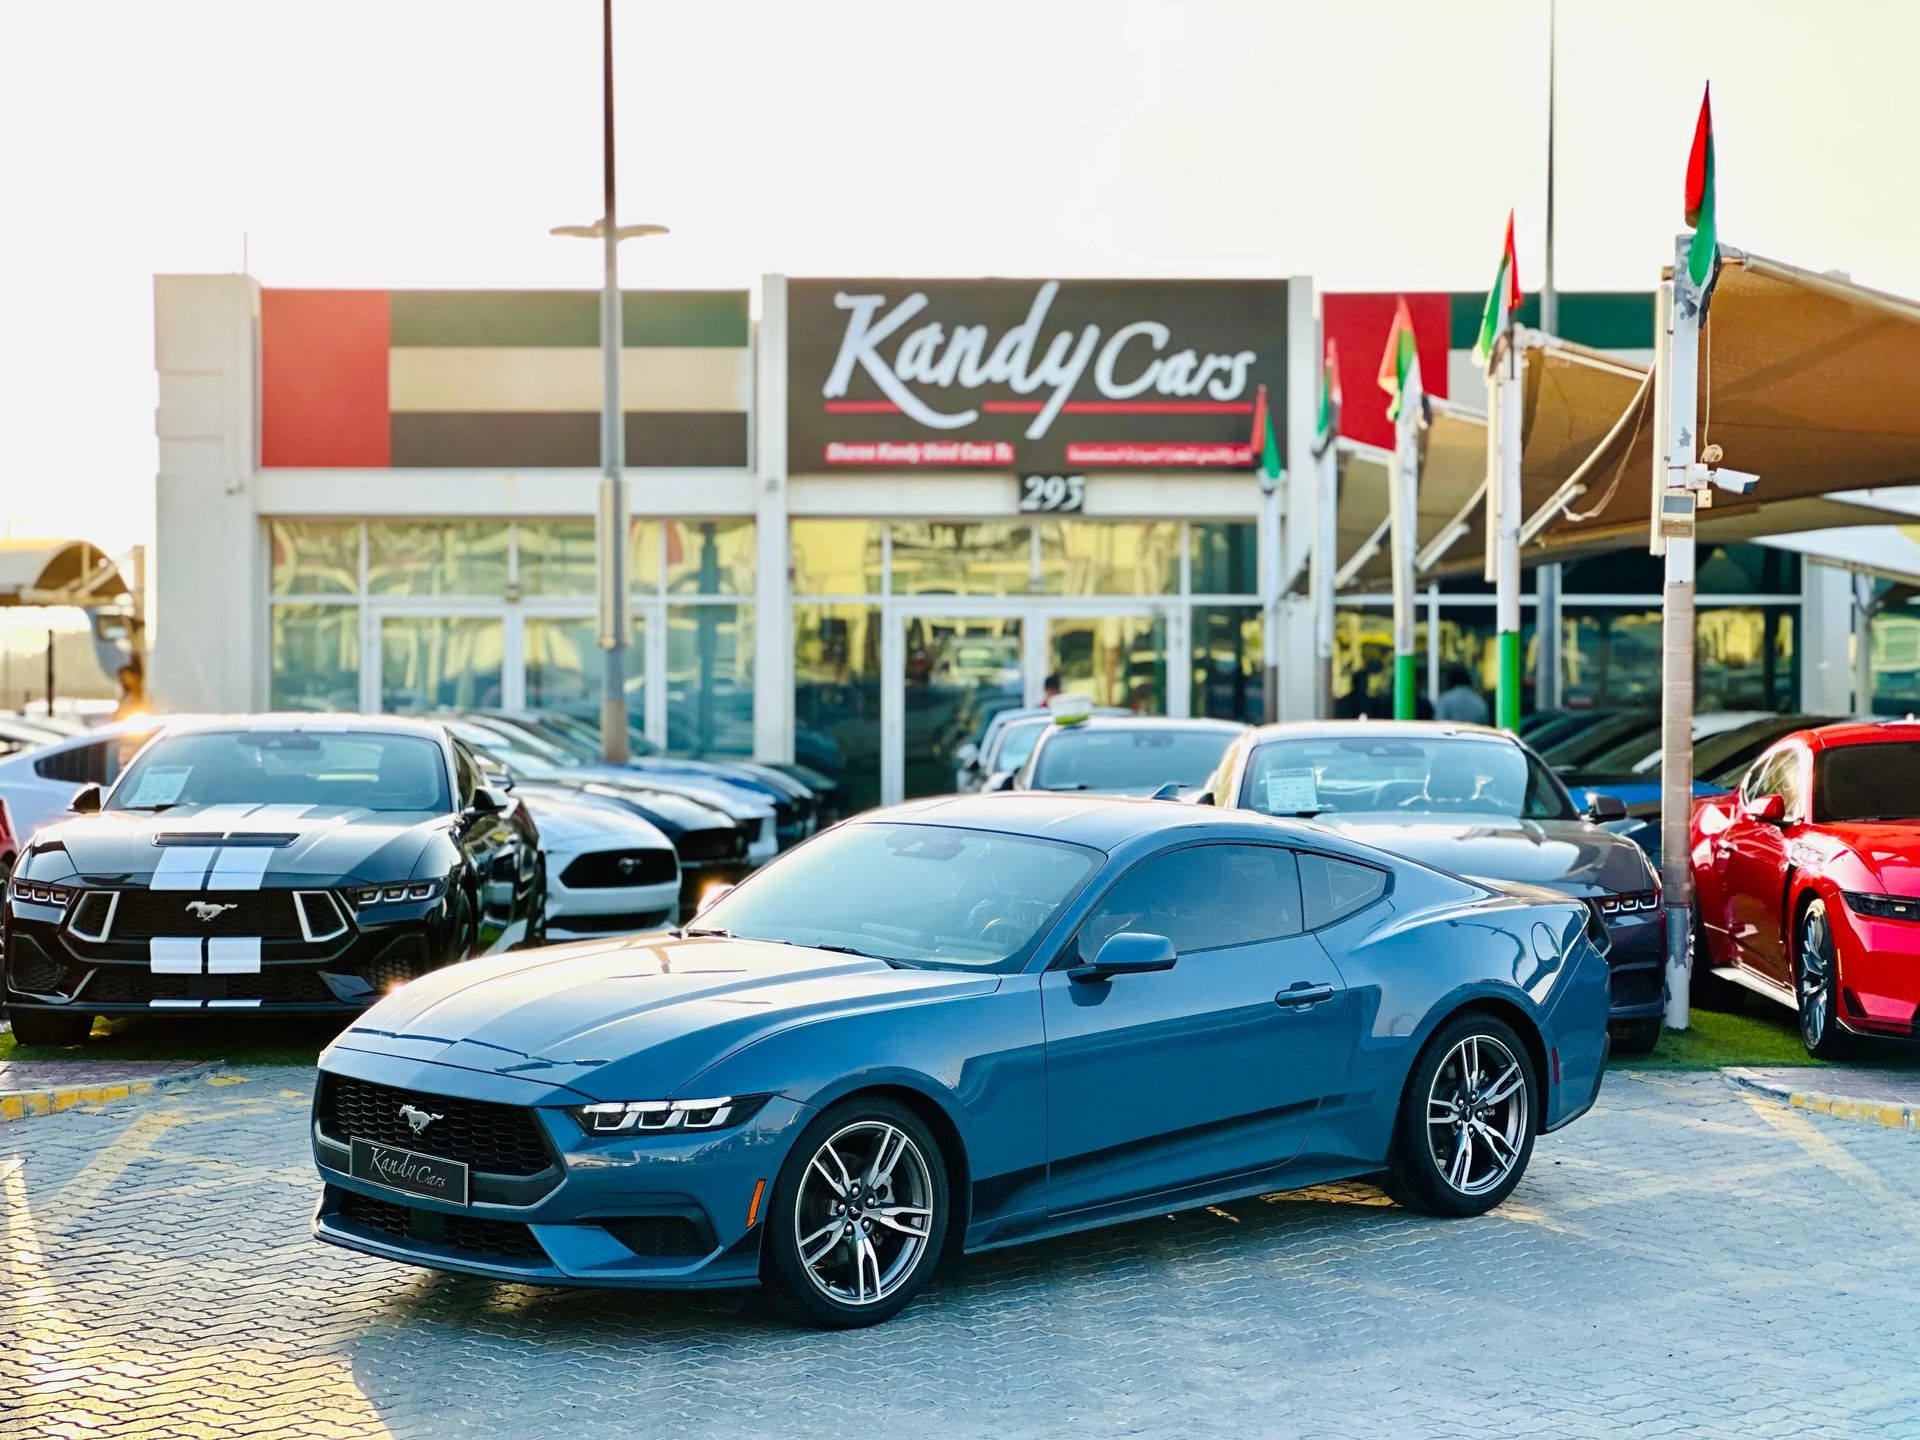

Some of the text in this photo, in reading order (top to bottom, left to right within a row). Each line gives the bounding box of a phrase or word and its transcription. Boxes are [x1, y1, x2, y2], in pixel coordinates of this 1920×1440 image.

[823, 280, 1257, 440] Kandy Cars
[1020, 475, 1085, 512] 295
[369, 1147, 446, 1188] Kandy Cars
